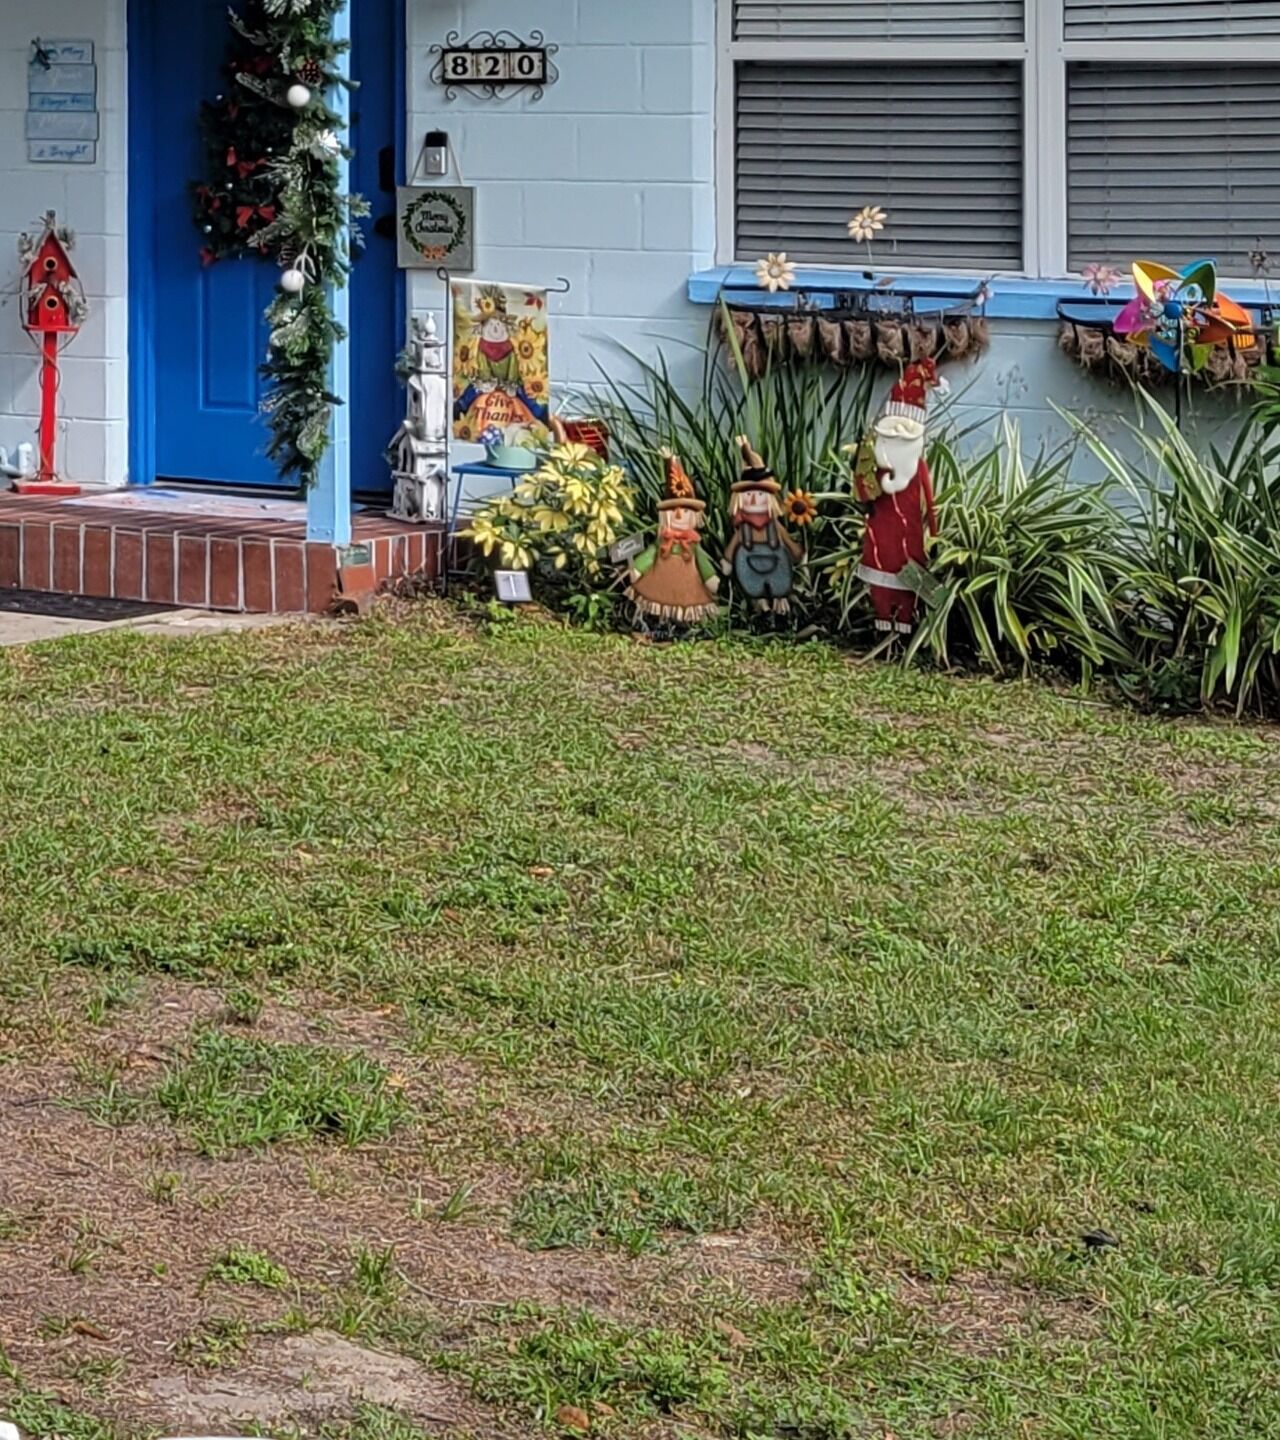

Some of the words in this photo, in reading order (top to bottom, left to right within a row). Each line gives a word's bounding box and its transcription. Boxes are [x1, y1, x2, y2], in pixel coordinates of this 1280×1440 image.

[451, 54, 535, 76] 820
[421, 210, 448, 225] Merry
[415, 220, 454, 234] Christmas
[485, 393, 515, 409] Give
[473, 406, 524, 424] Thanks
